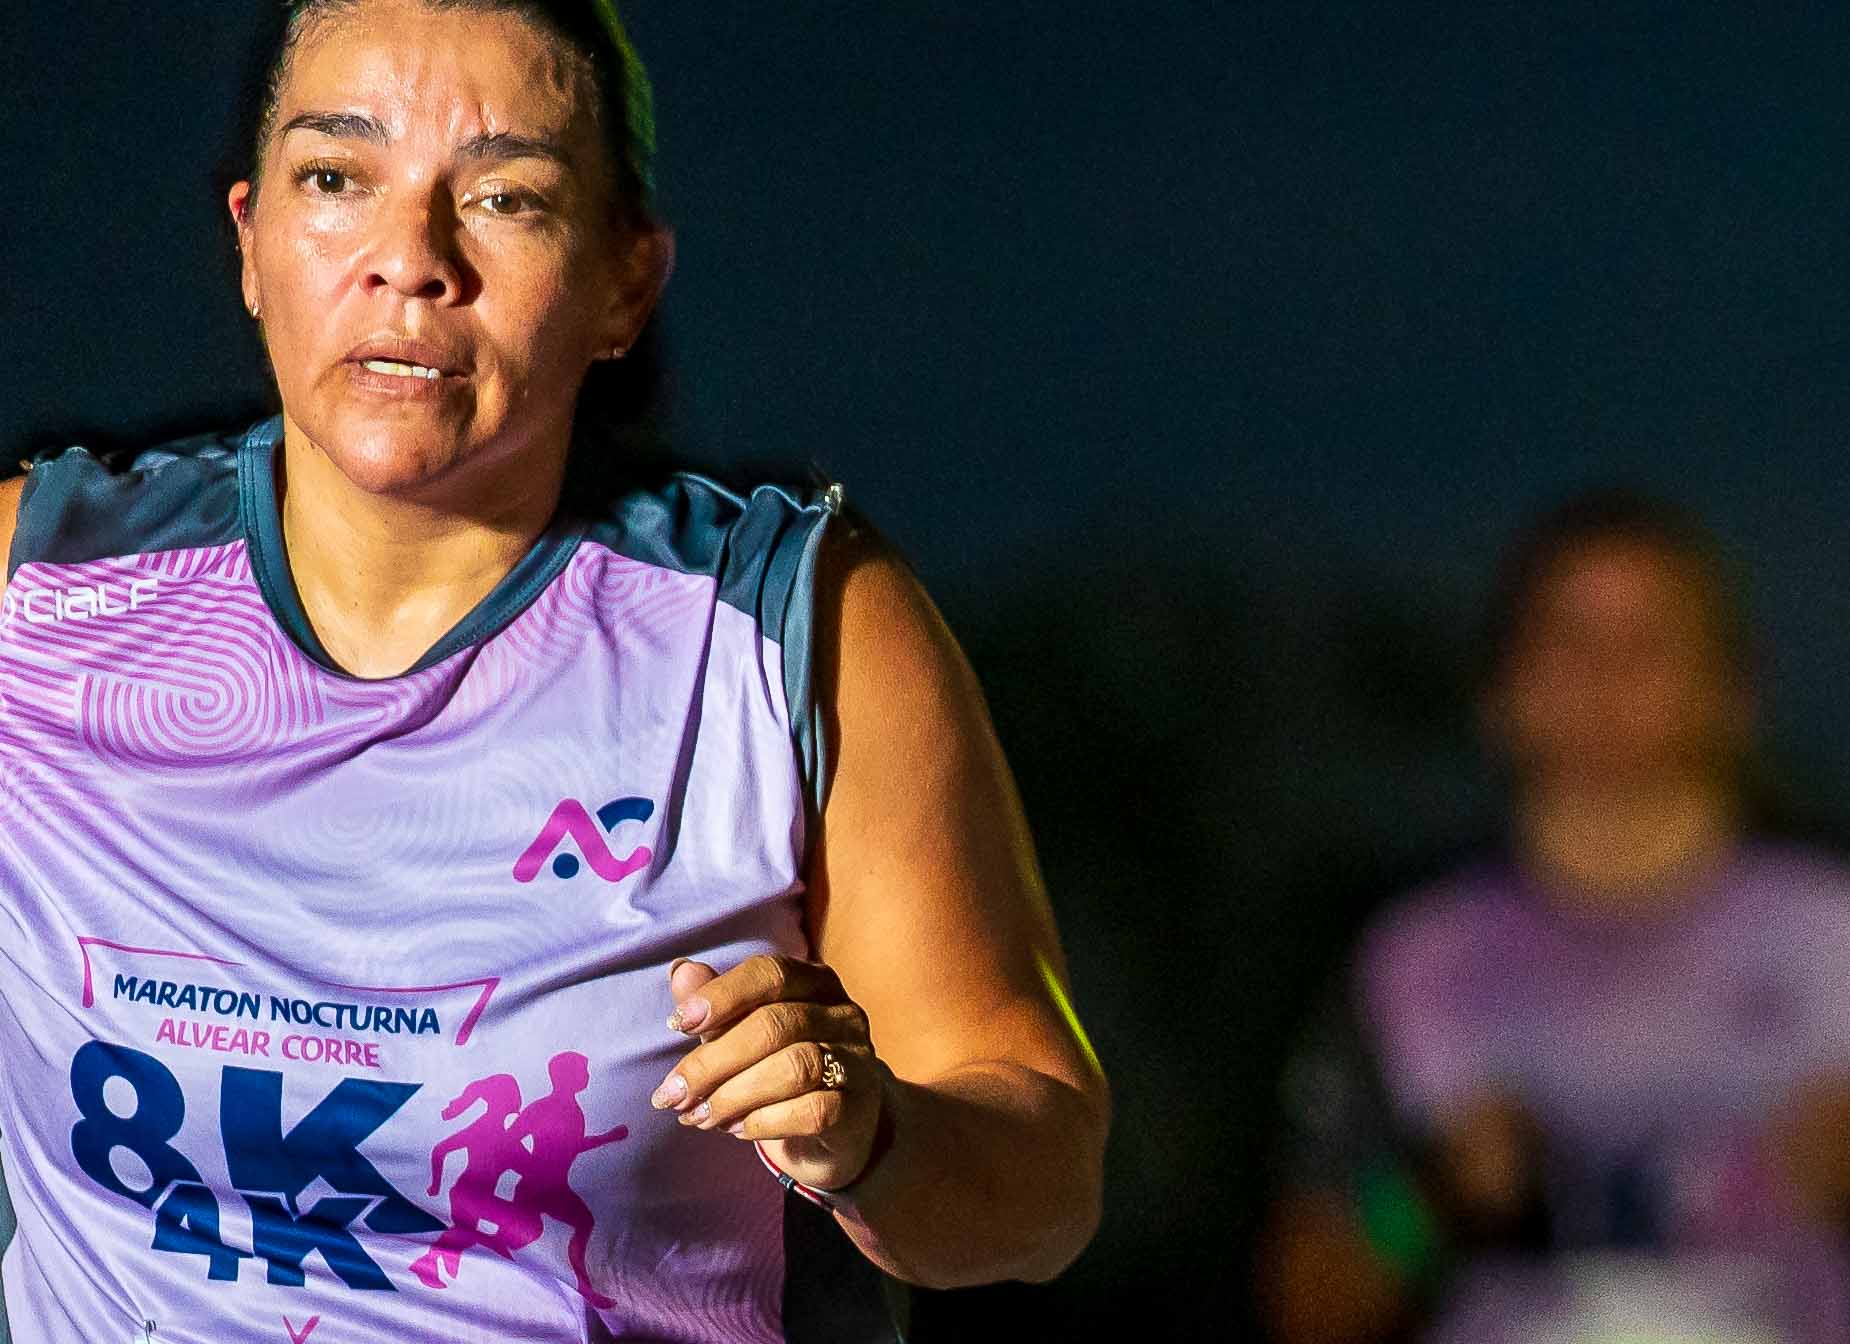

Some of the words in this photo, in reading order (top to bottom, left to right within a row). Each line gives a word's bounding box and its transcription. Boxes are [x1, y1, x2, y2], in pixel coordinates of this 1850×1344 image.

[113, 973, 261, 1021] MARATON
[270, 996, 441, 1035] NOCTURNA
[155, 1017, 271, 1056] ALVEAR
[281, 1035, 381, 1069] CORRE
[69, 1039, 451, 1235] 8K
[151, 1182, 399, 1292] 4K
